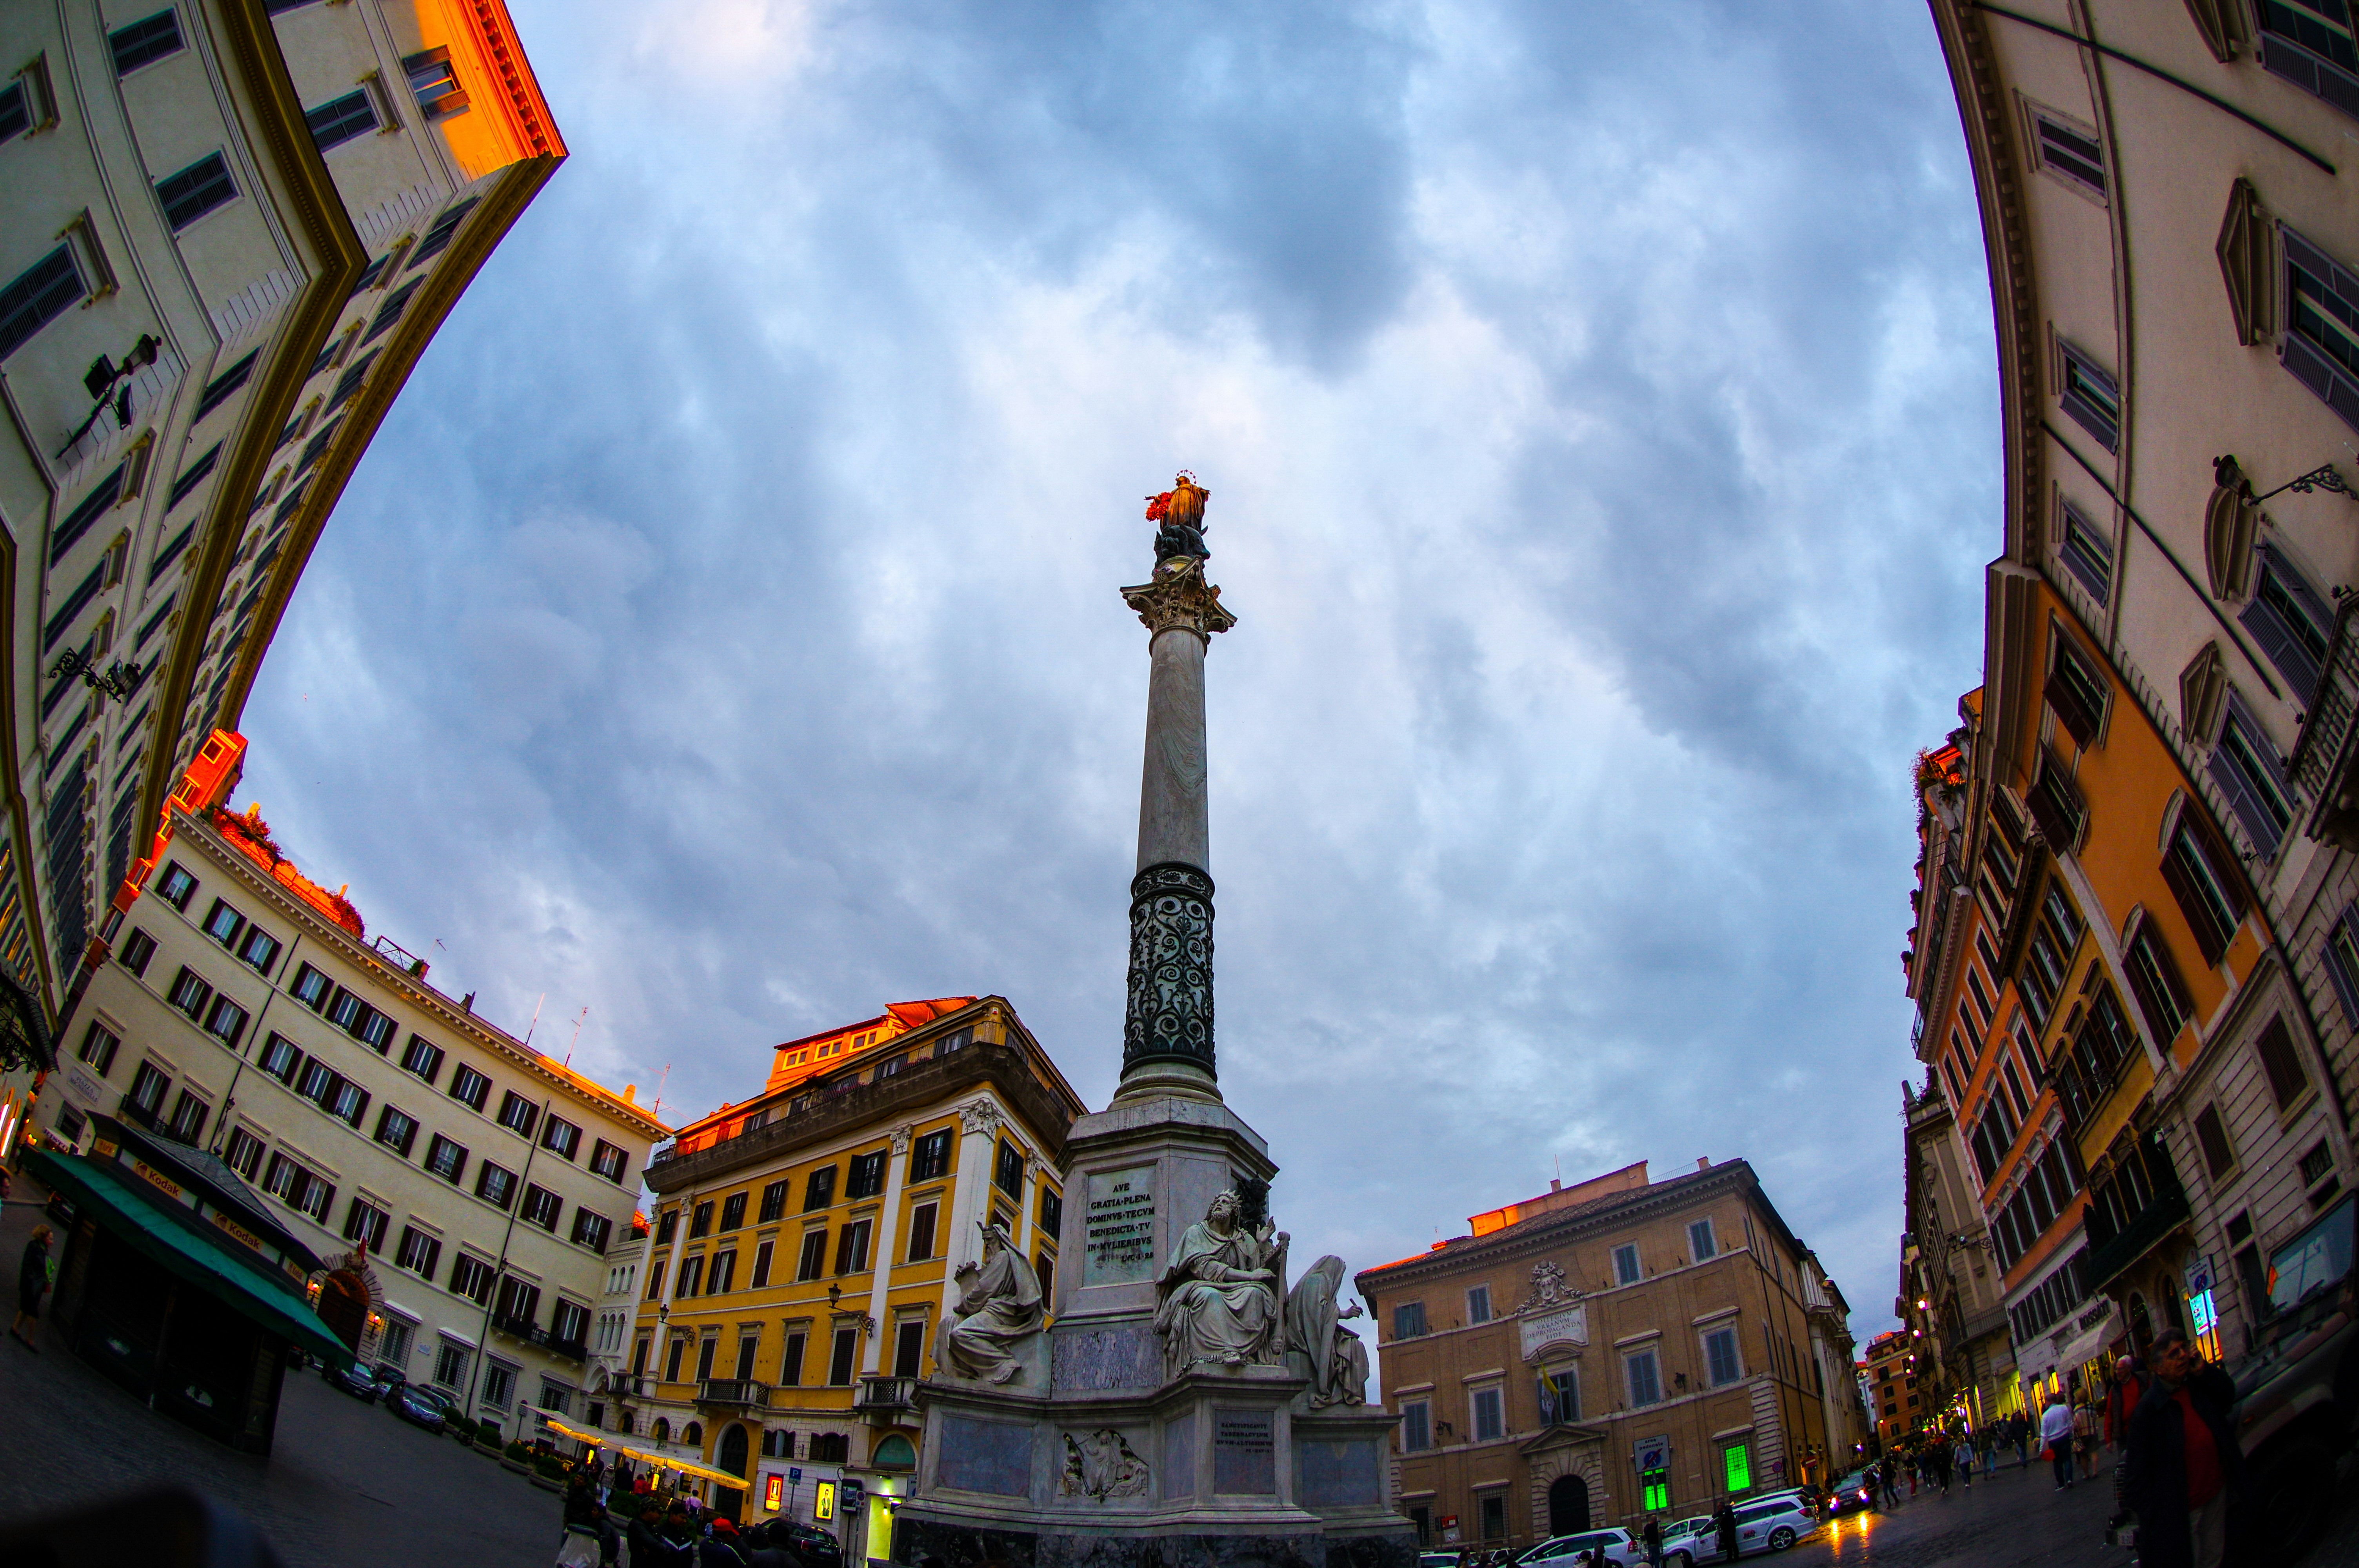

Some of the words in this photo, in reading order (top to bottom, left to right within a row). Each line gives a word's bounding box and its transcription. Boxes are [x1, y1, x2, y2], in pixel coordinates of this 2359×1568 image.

[149, 1171, 179, 1197] Kodak
[1113, 1183, 1130, 1192] AVE
[229, 1223, 260, 1249] Kodak
[1533, 1311, 1572, 1325] COLLEGIVM
[1537, 1318, 1570, 1330] VRBANVM
[1546, 1331, 1562, 1339] FIDE
[1639, 1442, 1663, 1451] pedonale
